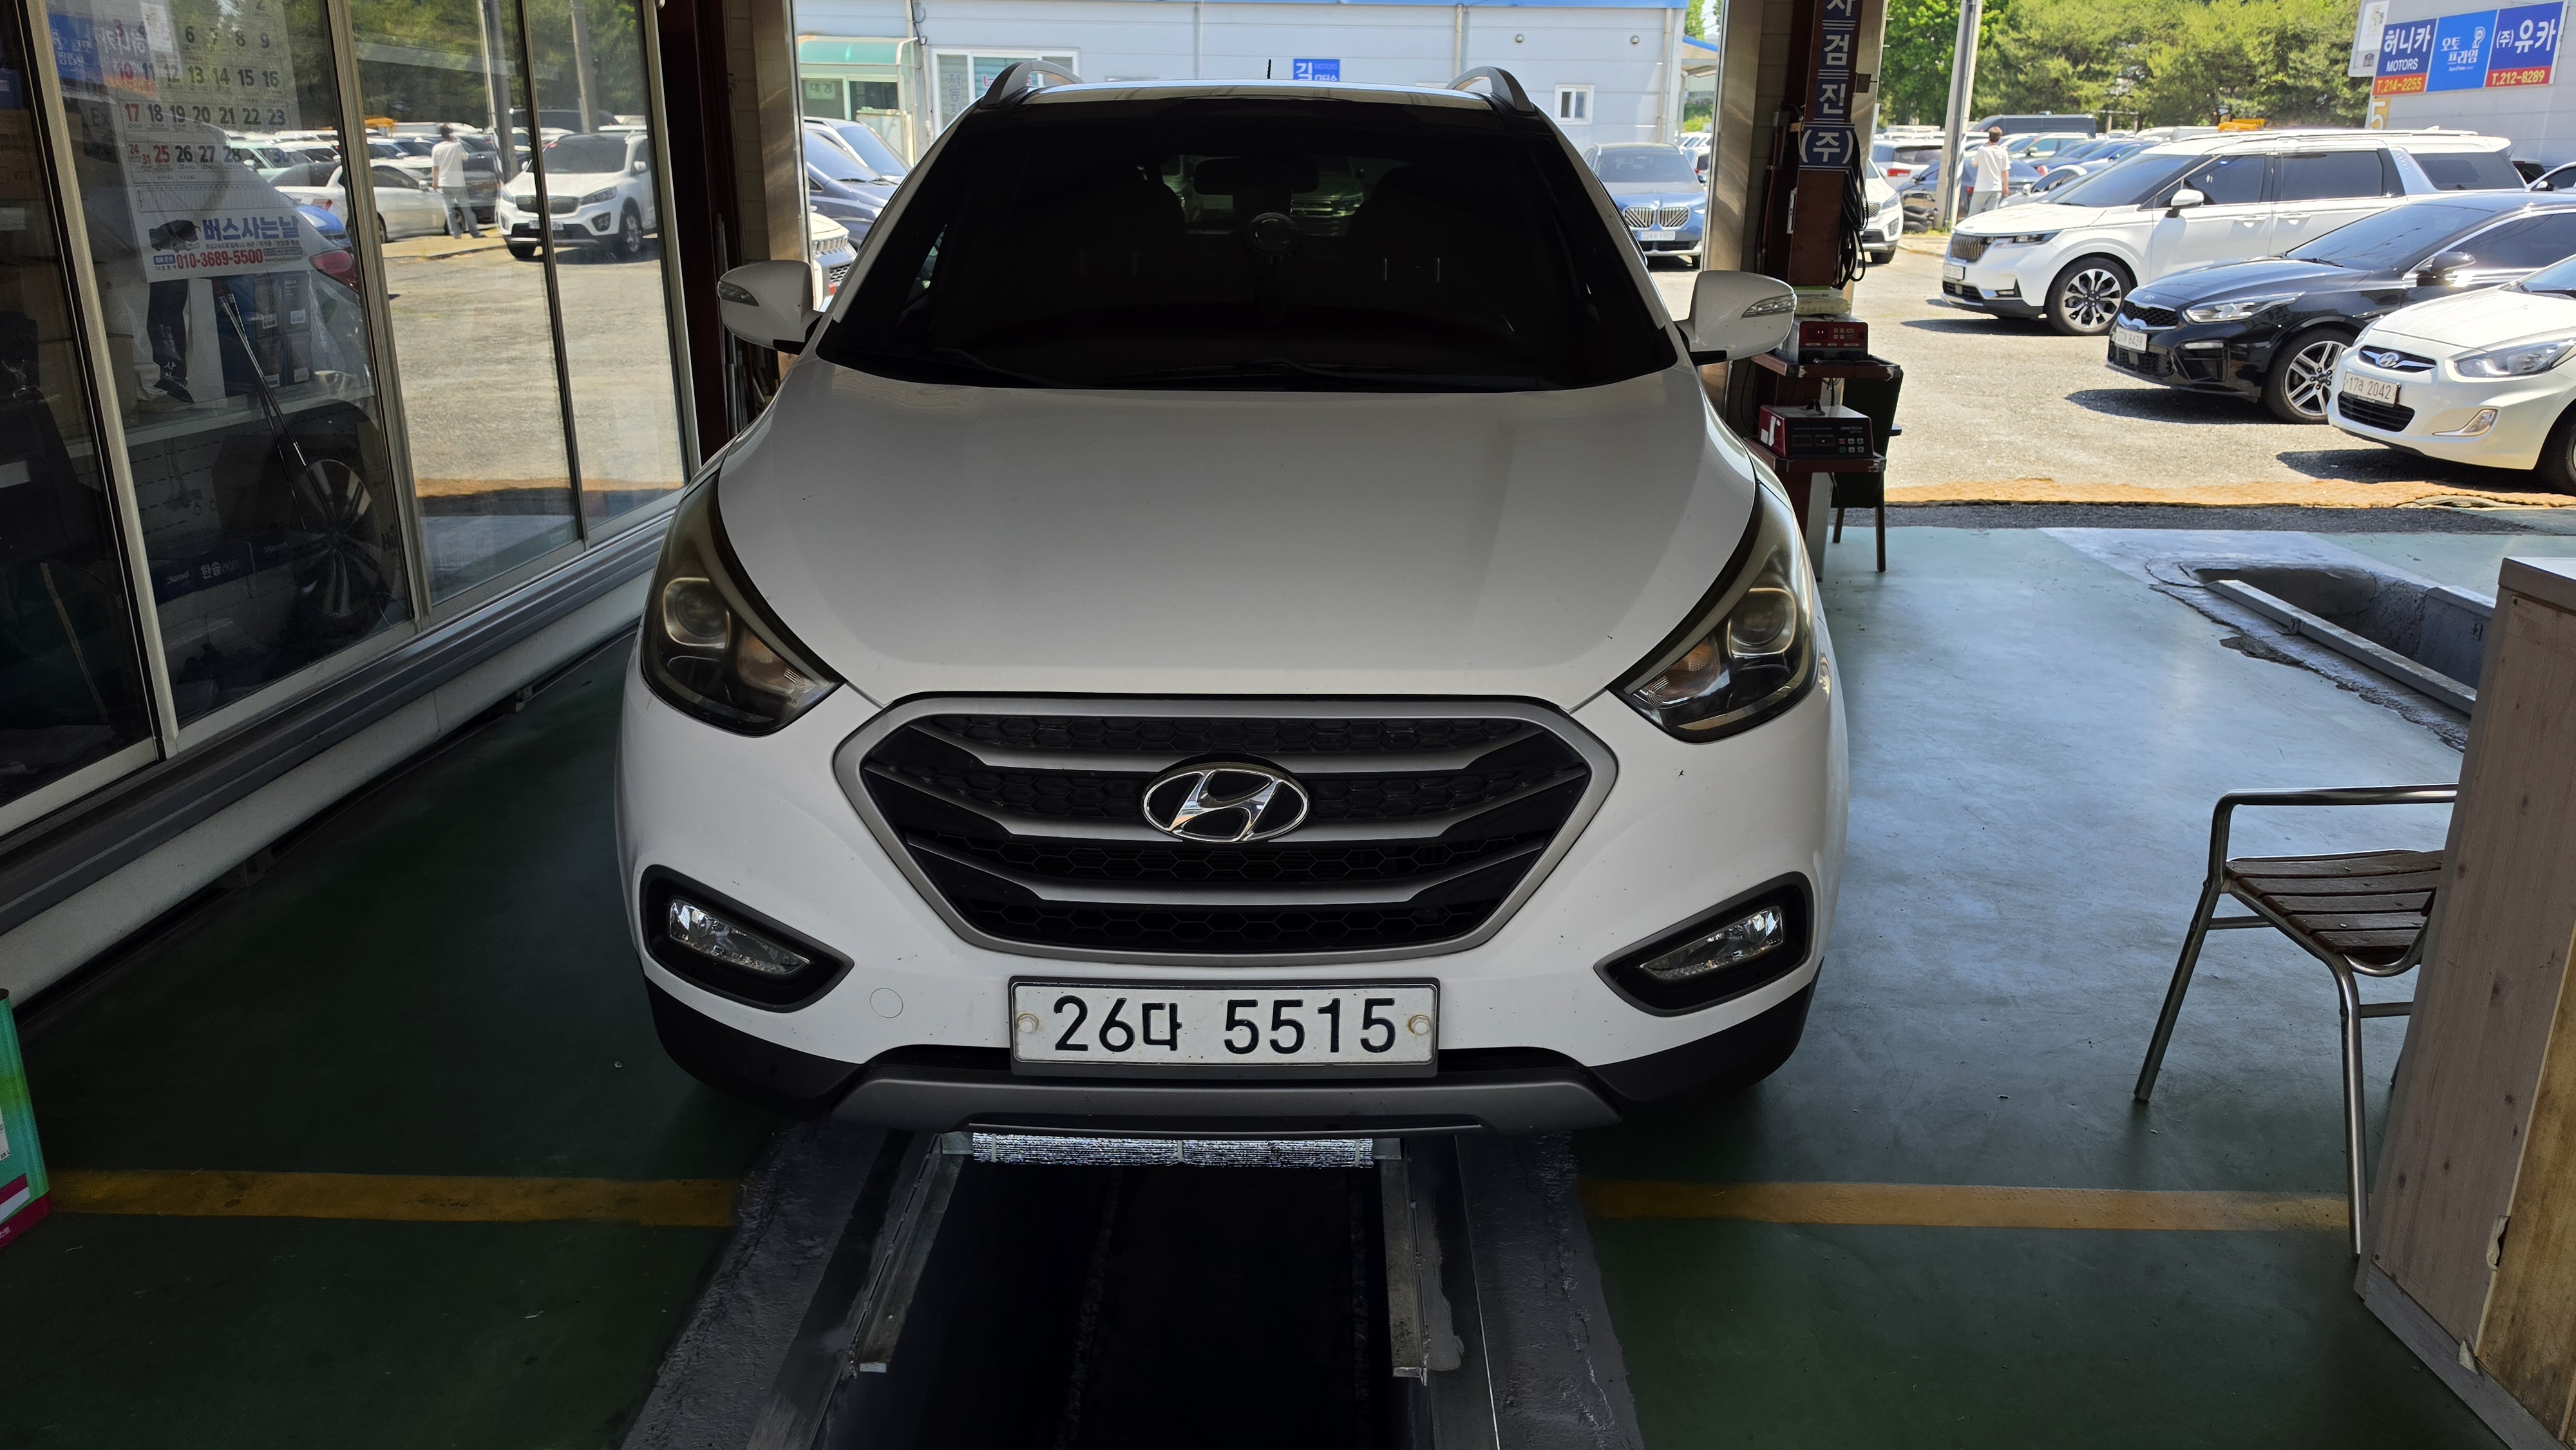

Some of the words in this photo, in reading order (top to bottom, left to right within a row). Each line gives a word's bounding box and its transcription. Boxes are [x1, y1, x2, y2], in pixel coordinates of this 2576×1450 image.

[185, 25, 195, 43] 6
[236, 29, 245, 47] 8
[260, 32, 270, 49] 9
[2384, 25, 2430, 55] 허니카
[2441, 37, 2461, 52] 오토
[2386, 58, 2418, 72] MOTORS
[2447, 49, 2478, 65] 프라임
[120, 62, 133, 80] 10
[142, 62, 155, 81] 11
[164, 64, 180, 82] 12
[187, 65, 205, 84] 13
[212, 67, 230, 85] 14
[237, 68, 254, 86] 15
[261, 70, 279, 88] 16
[1295, 62, 1312, 80] 김
[2492, 70, 2546, 86] T.212-8289
[2377, 77, 2423, 93] T.214-2255
[124, 103, 139, 122] 17
[147, 104, 163, 123] 18
[170, 105, 185, 123] 19
[193, 106, 211, 124] 20
[219, 107, 235, 125] 21
[242, 108, 261, 126] 22
[267, 109, 285, 126] 23
[129, 144, 139, 155] 24
[153, 145, 171, 164] 25
[175, 145, 193, 162] 26
[198, 145, 216, 162] 27
[223, 145, 242, 162] 28
[142, 154, 151, 165] 31
[202, 216, 299, 241] 버스사는날
[176, 249, 263, 270] 010-3689-5500
[2367, 381, 2391, 399] 2042
[1054, 995, 1182, 1053] 26다
[1224, 997, 1396, 1055] 5515
